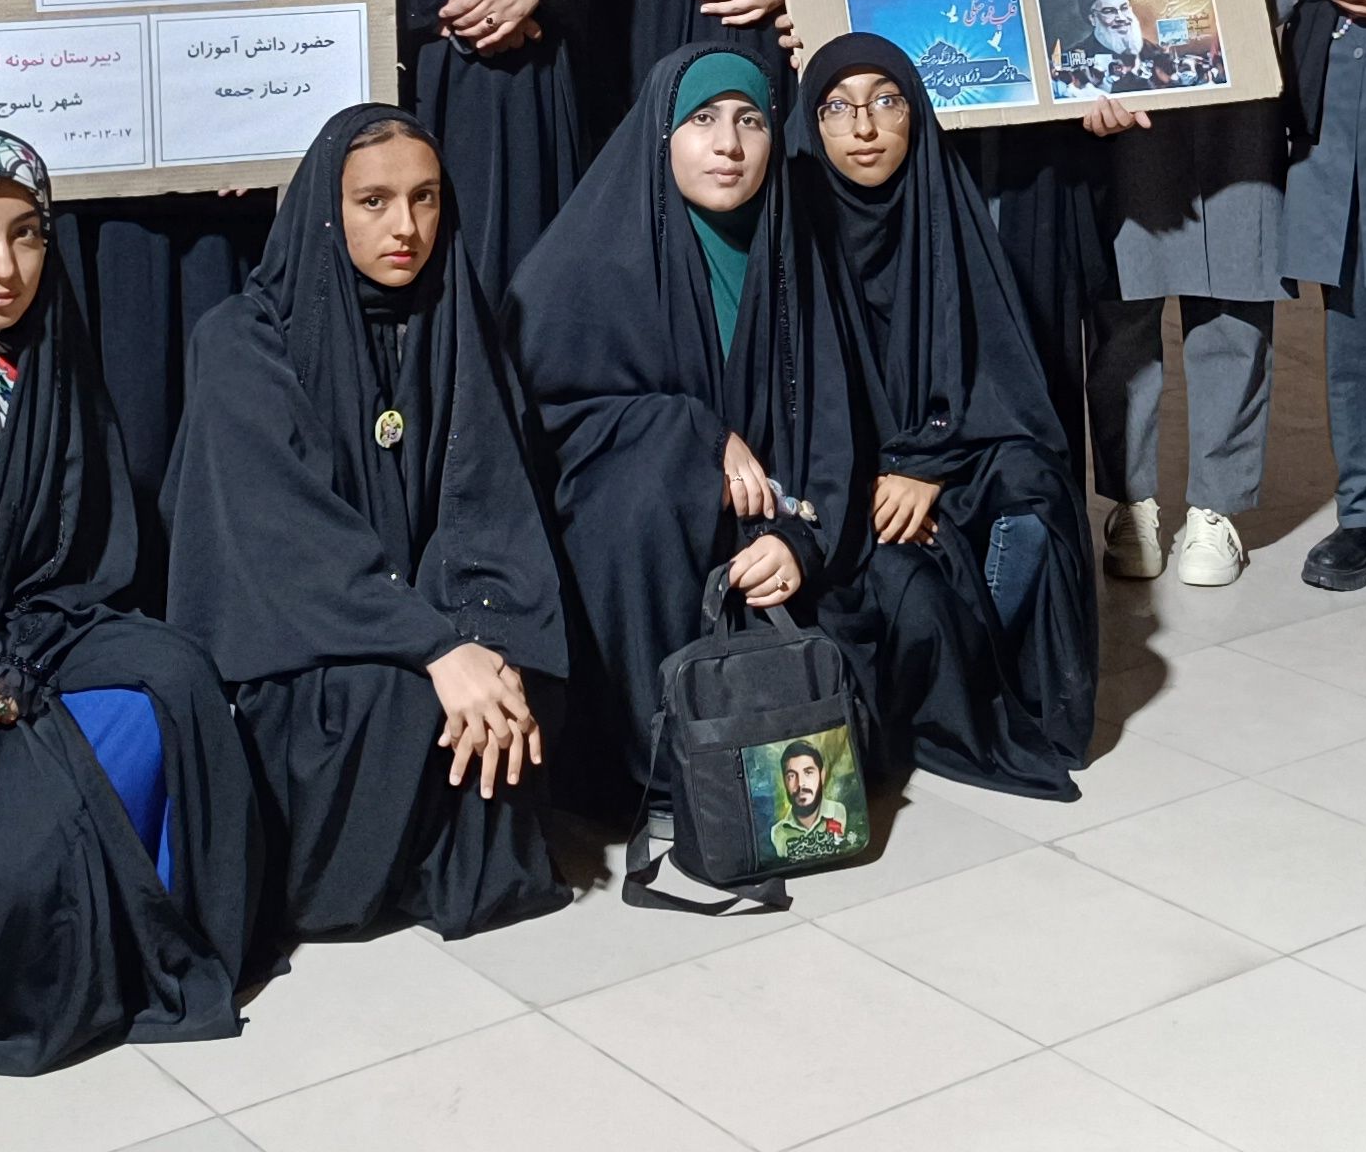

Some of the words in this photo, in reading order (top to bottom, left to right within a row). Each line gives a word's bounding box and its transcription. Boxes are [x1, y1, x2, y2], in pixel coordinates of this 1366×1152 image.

[187, 36, 239, 59] آموزان
[245, 37, 286, 58] دانش
[291, 36, 335, 55] حضور
[5, 53, 45, 72] نمونه
[50, 50, 121, 68] دبیرستان
[215, 86, 254, 100] جمعه
[260, 81, 288, 99] نماز
[293, 82, 311, 96] در
[50, 92, 83, 112] شهر
